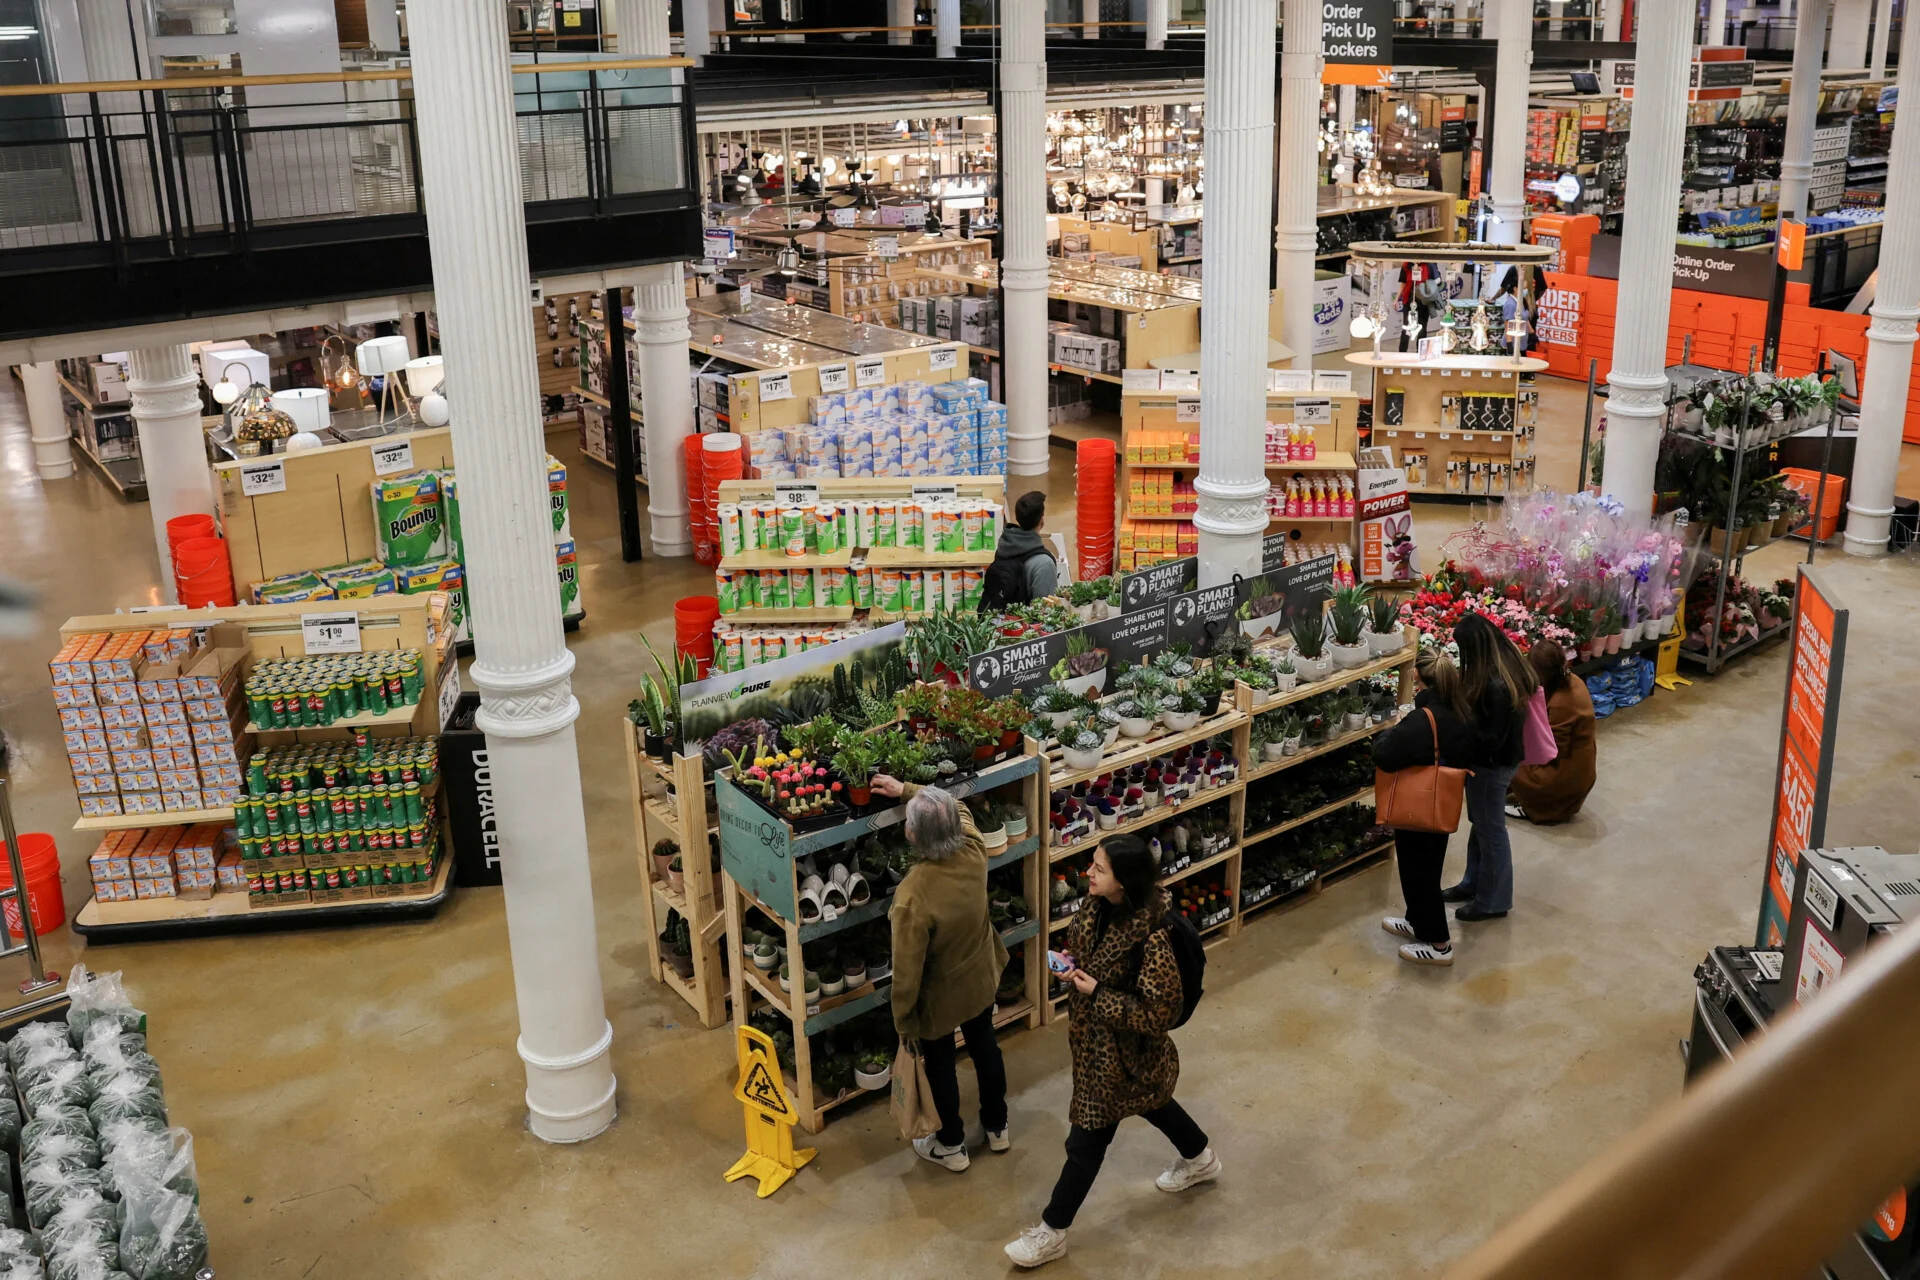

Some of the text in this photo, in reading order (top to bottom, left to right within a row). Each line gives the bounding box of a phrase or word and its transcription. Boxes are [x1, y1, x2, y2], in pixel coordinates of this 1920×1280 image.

[1323, 3, 1363, 19] Order
[1322, 22, 1376, 42] Pick Up
[1321, 41, 1378, 57] Lockers
[1444, 97, 1451, 106] 14
[1583, 104, 1591, 114] 13
[1672, 254, 1736, 272] Online Order
[1672, 266, 1710, 282] Pick-Up
[1318, 306, 1341, 324] Beds
[765, 382, 778, 391] $17
[1304, 407, 1314, 416] $5
[251, 473, 268, 484] $32
[1368, 478, 1399, 491] Energizer
[1363, 494, 1406, 514] POWER
[389, 505, 437, 540] Bounty
[1268, 536, 1285, 545] YOUR
[1149, 563, 1185, 583] SMART
[1299, 557, 1334, 573] SHARE YOUR
[1288, 566, 1333, 586] LOVE OF PLANTS
[1197, 585, 1236, 605] SMART
[1124, 608, 1165, 626] SHARE YOUR
[319, 627, 332, 639] $1
[332, 627, 342, 635] 00
[1111, 619, 1165, 641] LOVE OF PLANTS
[1800, 612, 1831, 662] SPECIAL BUY
[1002, 640, 1047, 665] SMART
[1799, 630, 1829, 683] SAVINGS ON
[1796, 650, 1827, 704] APPLIANCES
[691, 679, 771, 709] PLAINVIEW PURE
[471, 749, 501, 870] DURACELL
[1782, 762, 1814, 851] $450
